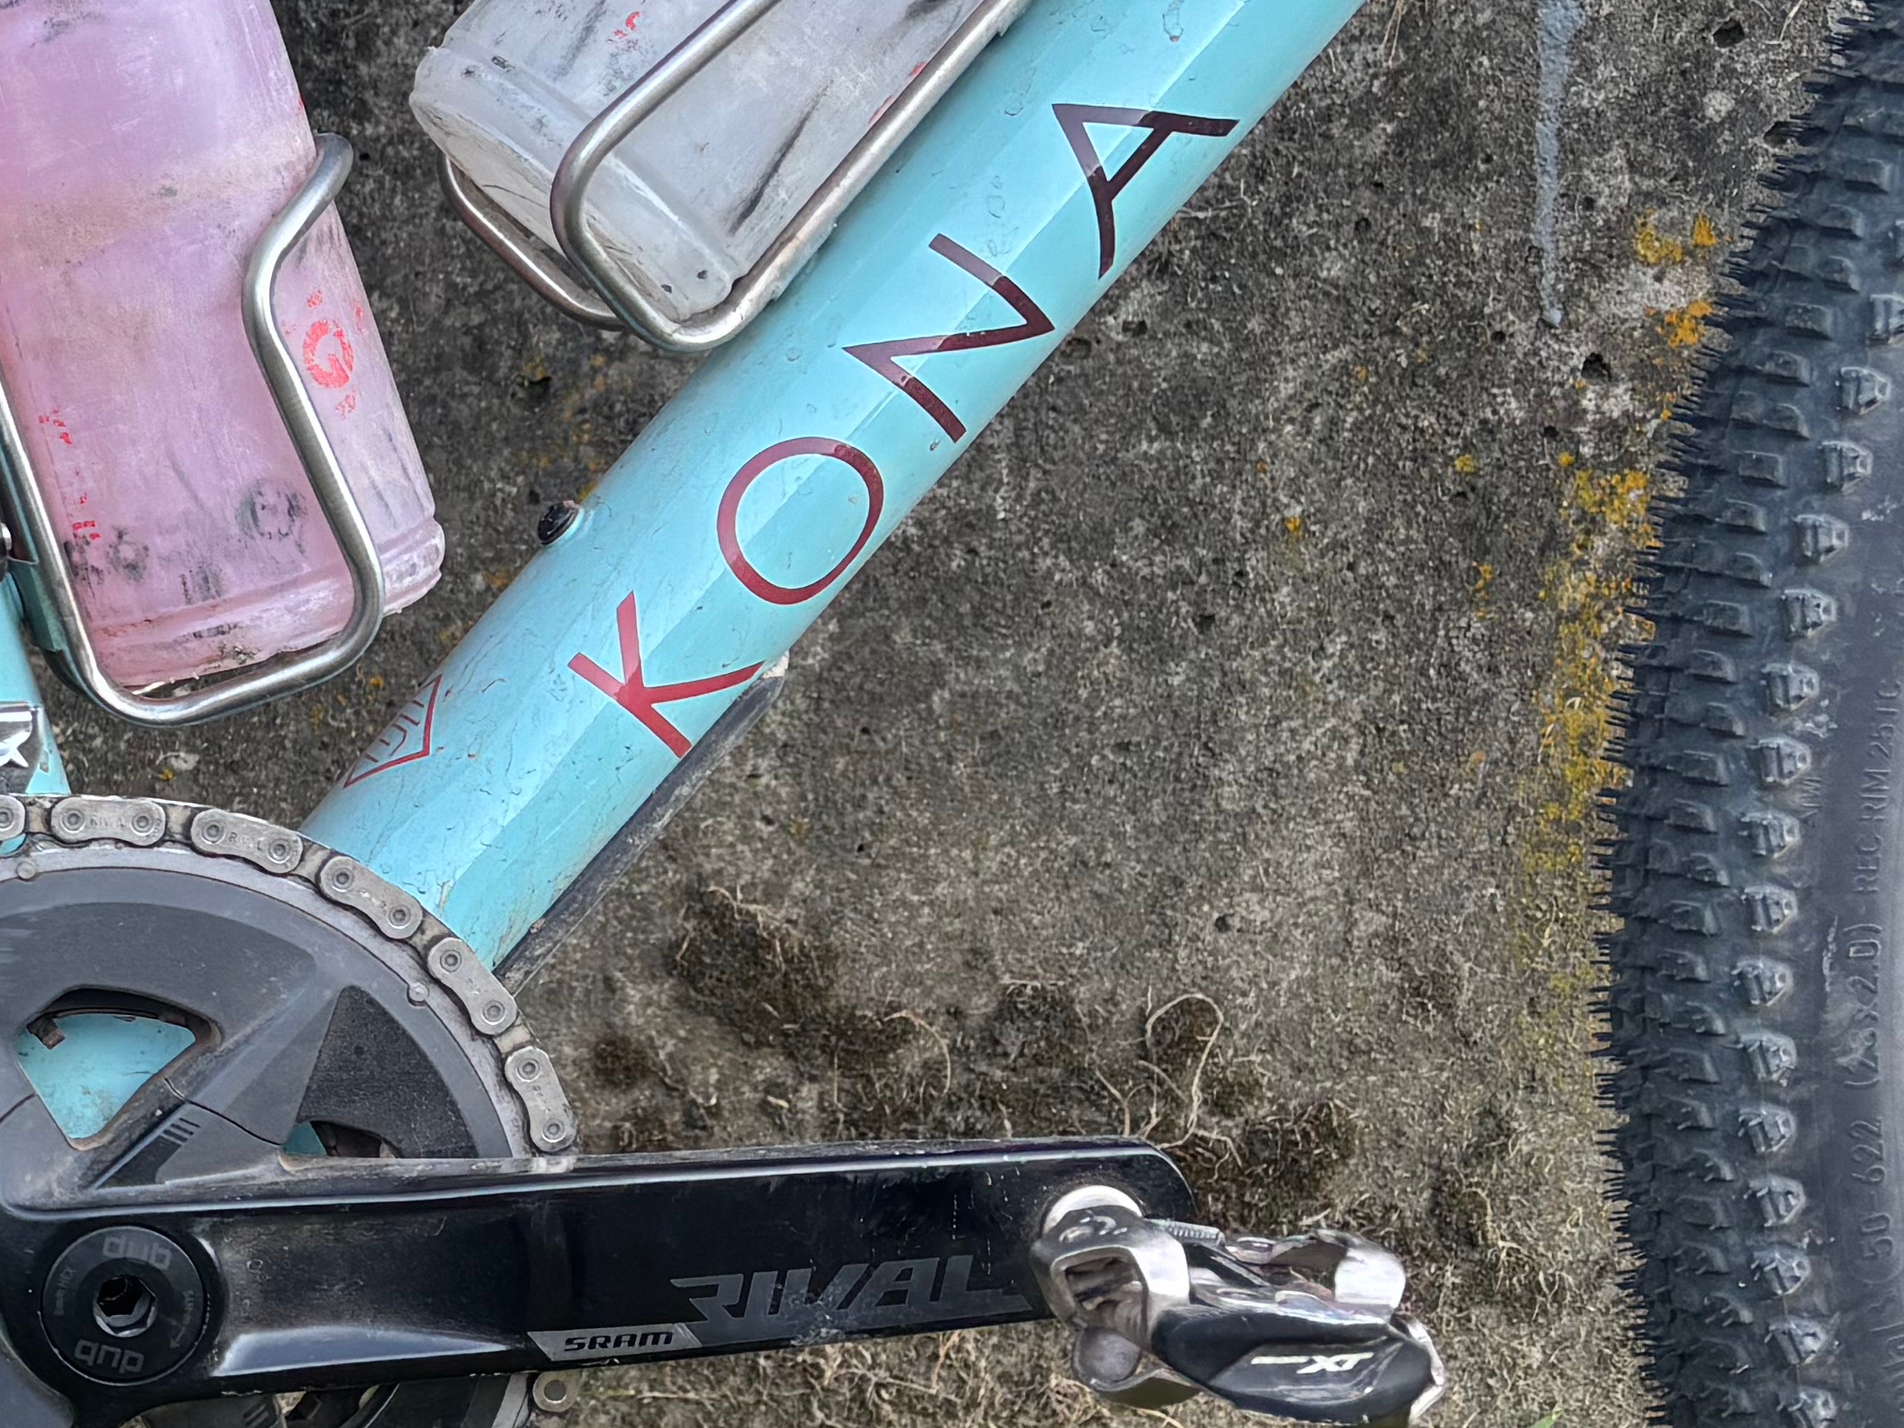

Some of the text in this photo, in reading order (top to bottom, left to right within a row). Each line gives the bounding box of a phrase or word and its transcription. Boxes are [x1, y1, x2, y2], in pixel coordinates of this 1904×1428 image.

[568, 102, 1240, 759] KONA
[101, 1235, 173, 1271] dub
[670, 1254, 1034, 1347] RIVAL
[74, 1338, 145, 1374] dub
[563, 1331, 674, 1353] SRAM
